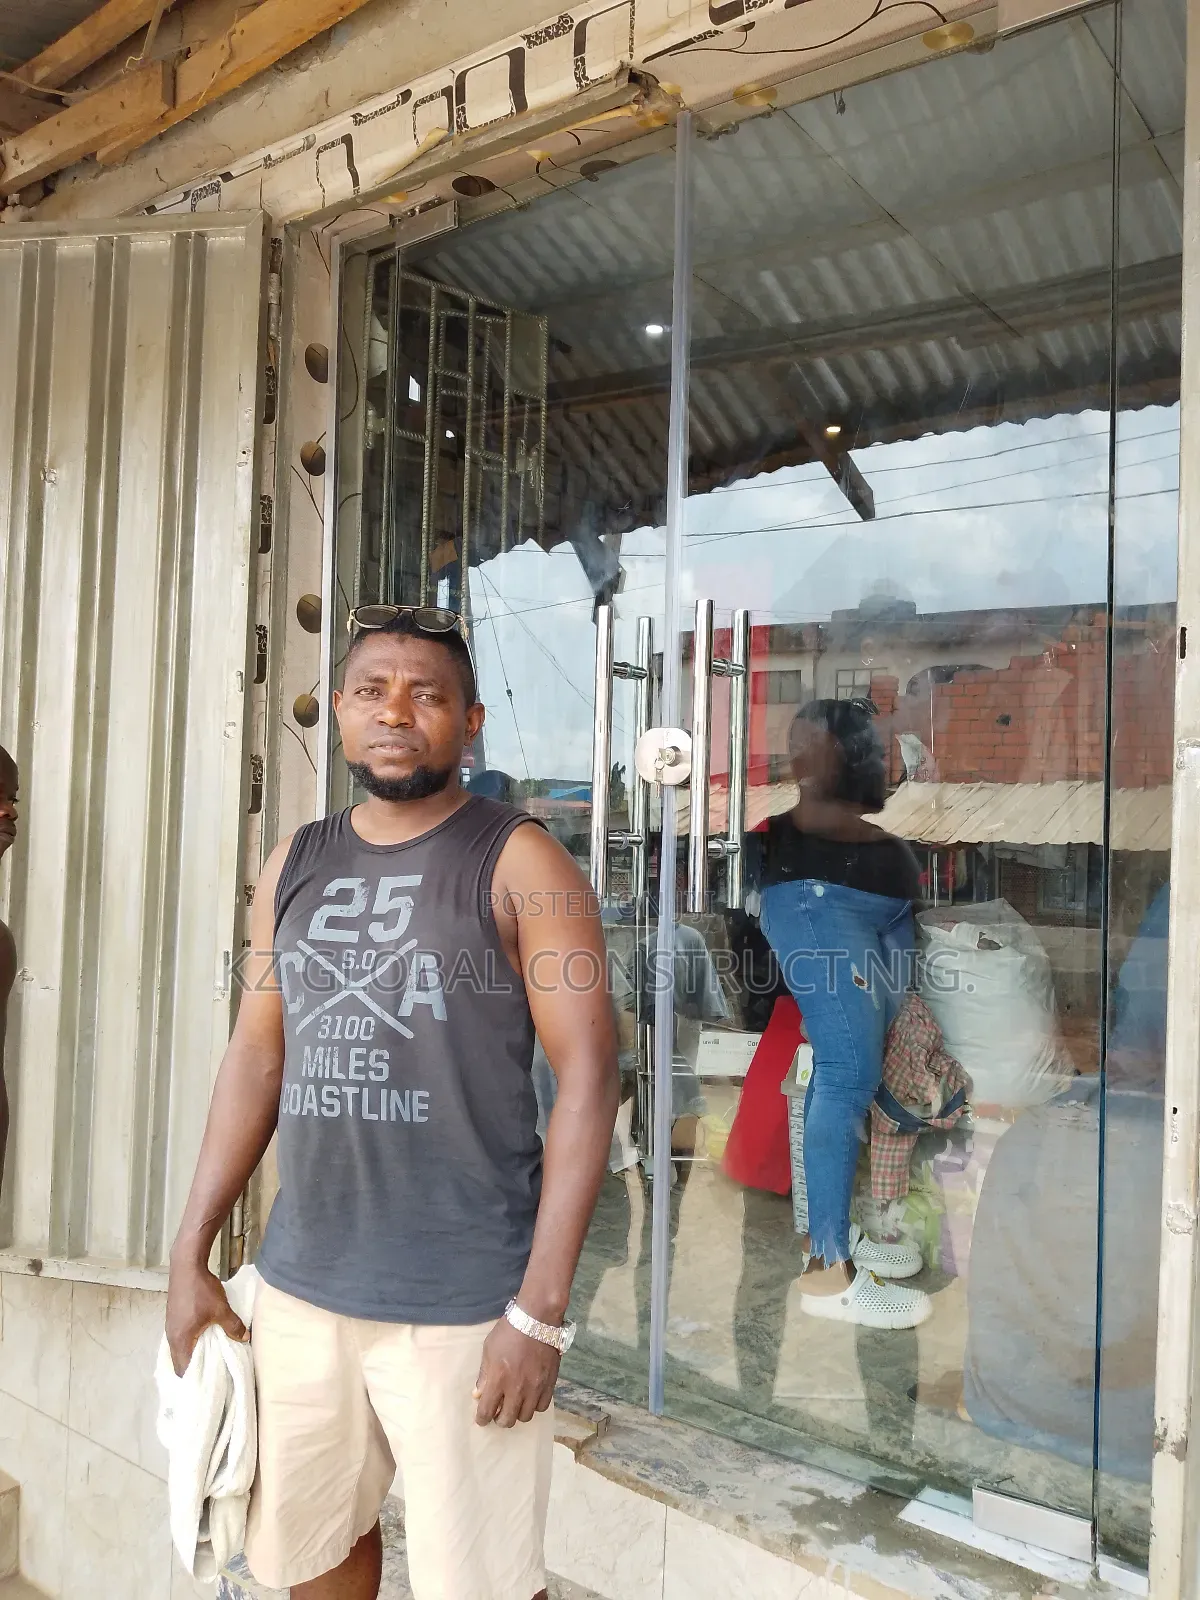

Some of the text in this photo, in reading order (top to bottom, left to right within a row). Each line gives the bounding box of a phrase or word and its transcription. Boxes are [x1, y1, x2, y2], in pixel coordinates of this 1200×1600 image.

[307, 874, 424, 943] 25
[317, 1015, 376, 1041] 3100
[301, 1046, 390, 1082] MILES
[281, 1083, 430, 1123] COASTLINE
